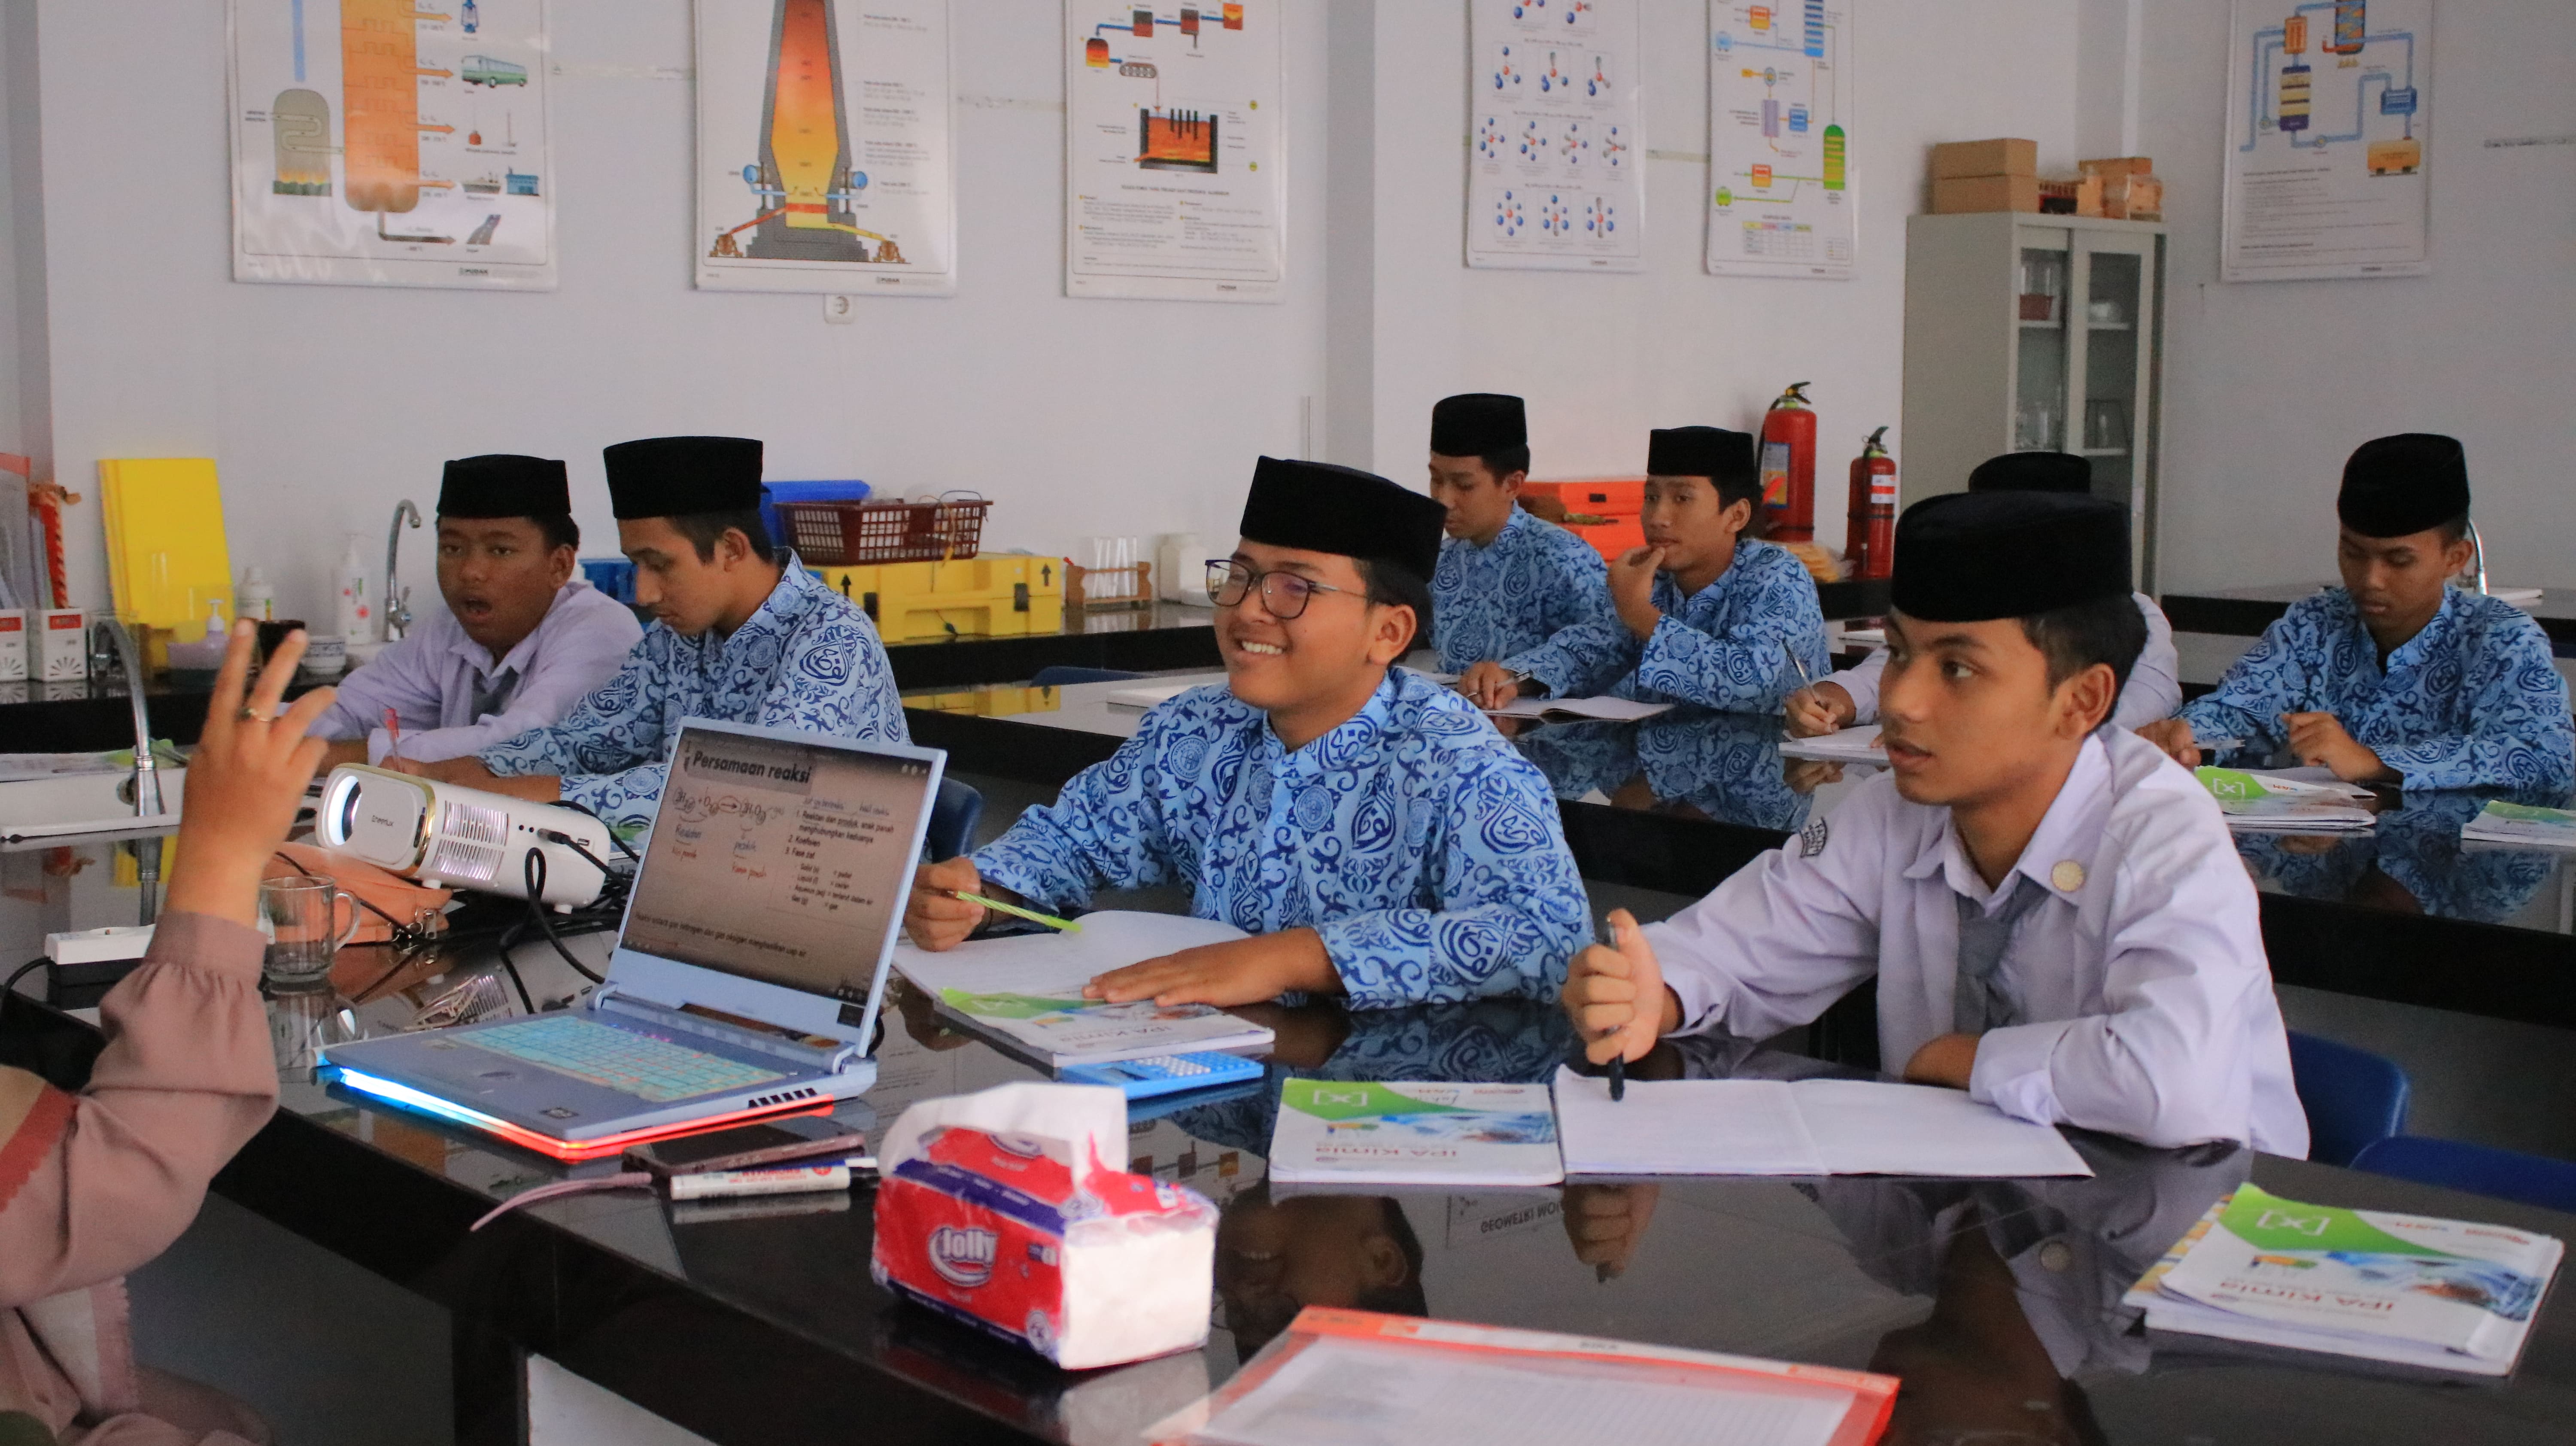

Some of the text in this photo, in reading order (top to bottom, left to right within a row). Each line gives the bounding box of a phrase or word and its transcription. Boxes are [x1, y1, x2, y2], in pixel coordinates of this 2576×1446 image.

[693, 750, 812, 784] Persamaan reaksi
[875, 824, 894, 833] panah
[799, 825, 874, 845] menghubungkan keduanya
[795, 835, 820, 847] Koefisien
[792, 848, 805, 857] Fase
[851, 895, 866, 903] dalam
[703, 928, 714, 937] dan
[1410, 1149, 1457, 1157] IPA
[2220, 1282, 2394, 1312] IPA Kimia
